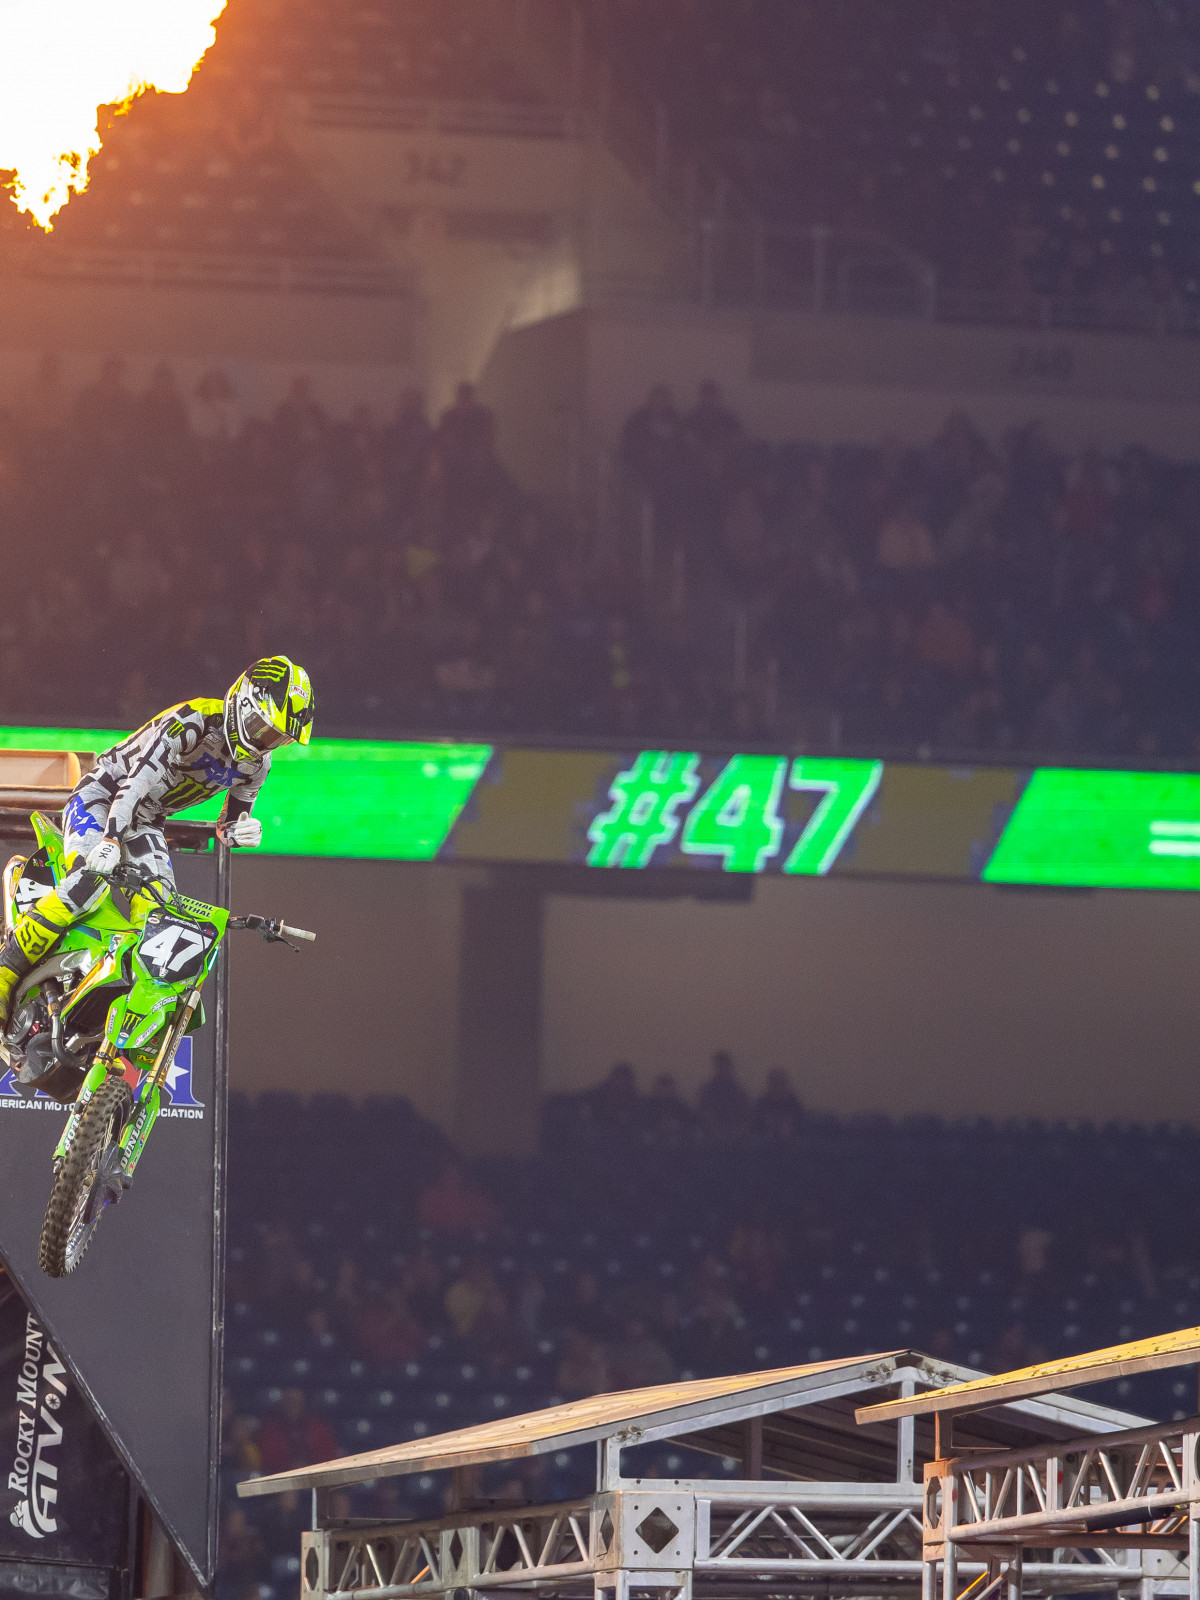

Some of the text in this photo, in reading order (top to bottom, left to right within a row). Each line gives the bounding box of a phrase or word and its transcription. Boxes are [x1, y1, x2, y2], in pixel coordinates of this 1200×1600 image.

[586, 750, 884, 876] #47
[139, 924, 212, 973] 47
[120, 1108, 148, 1169] DUNLOP
[8, 1312, 44, 1496] ROCKY MOUNT
